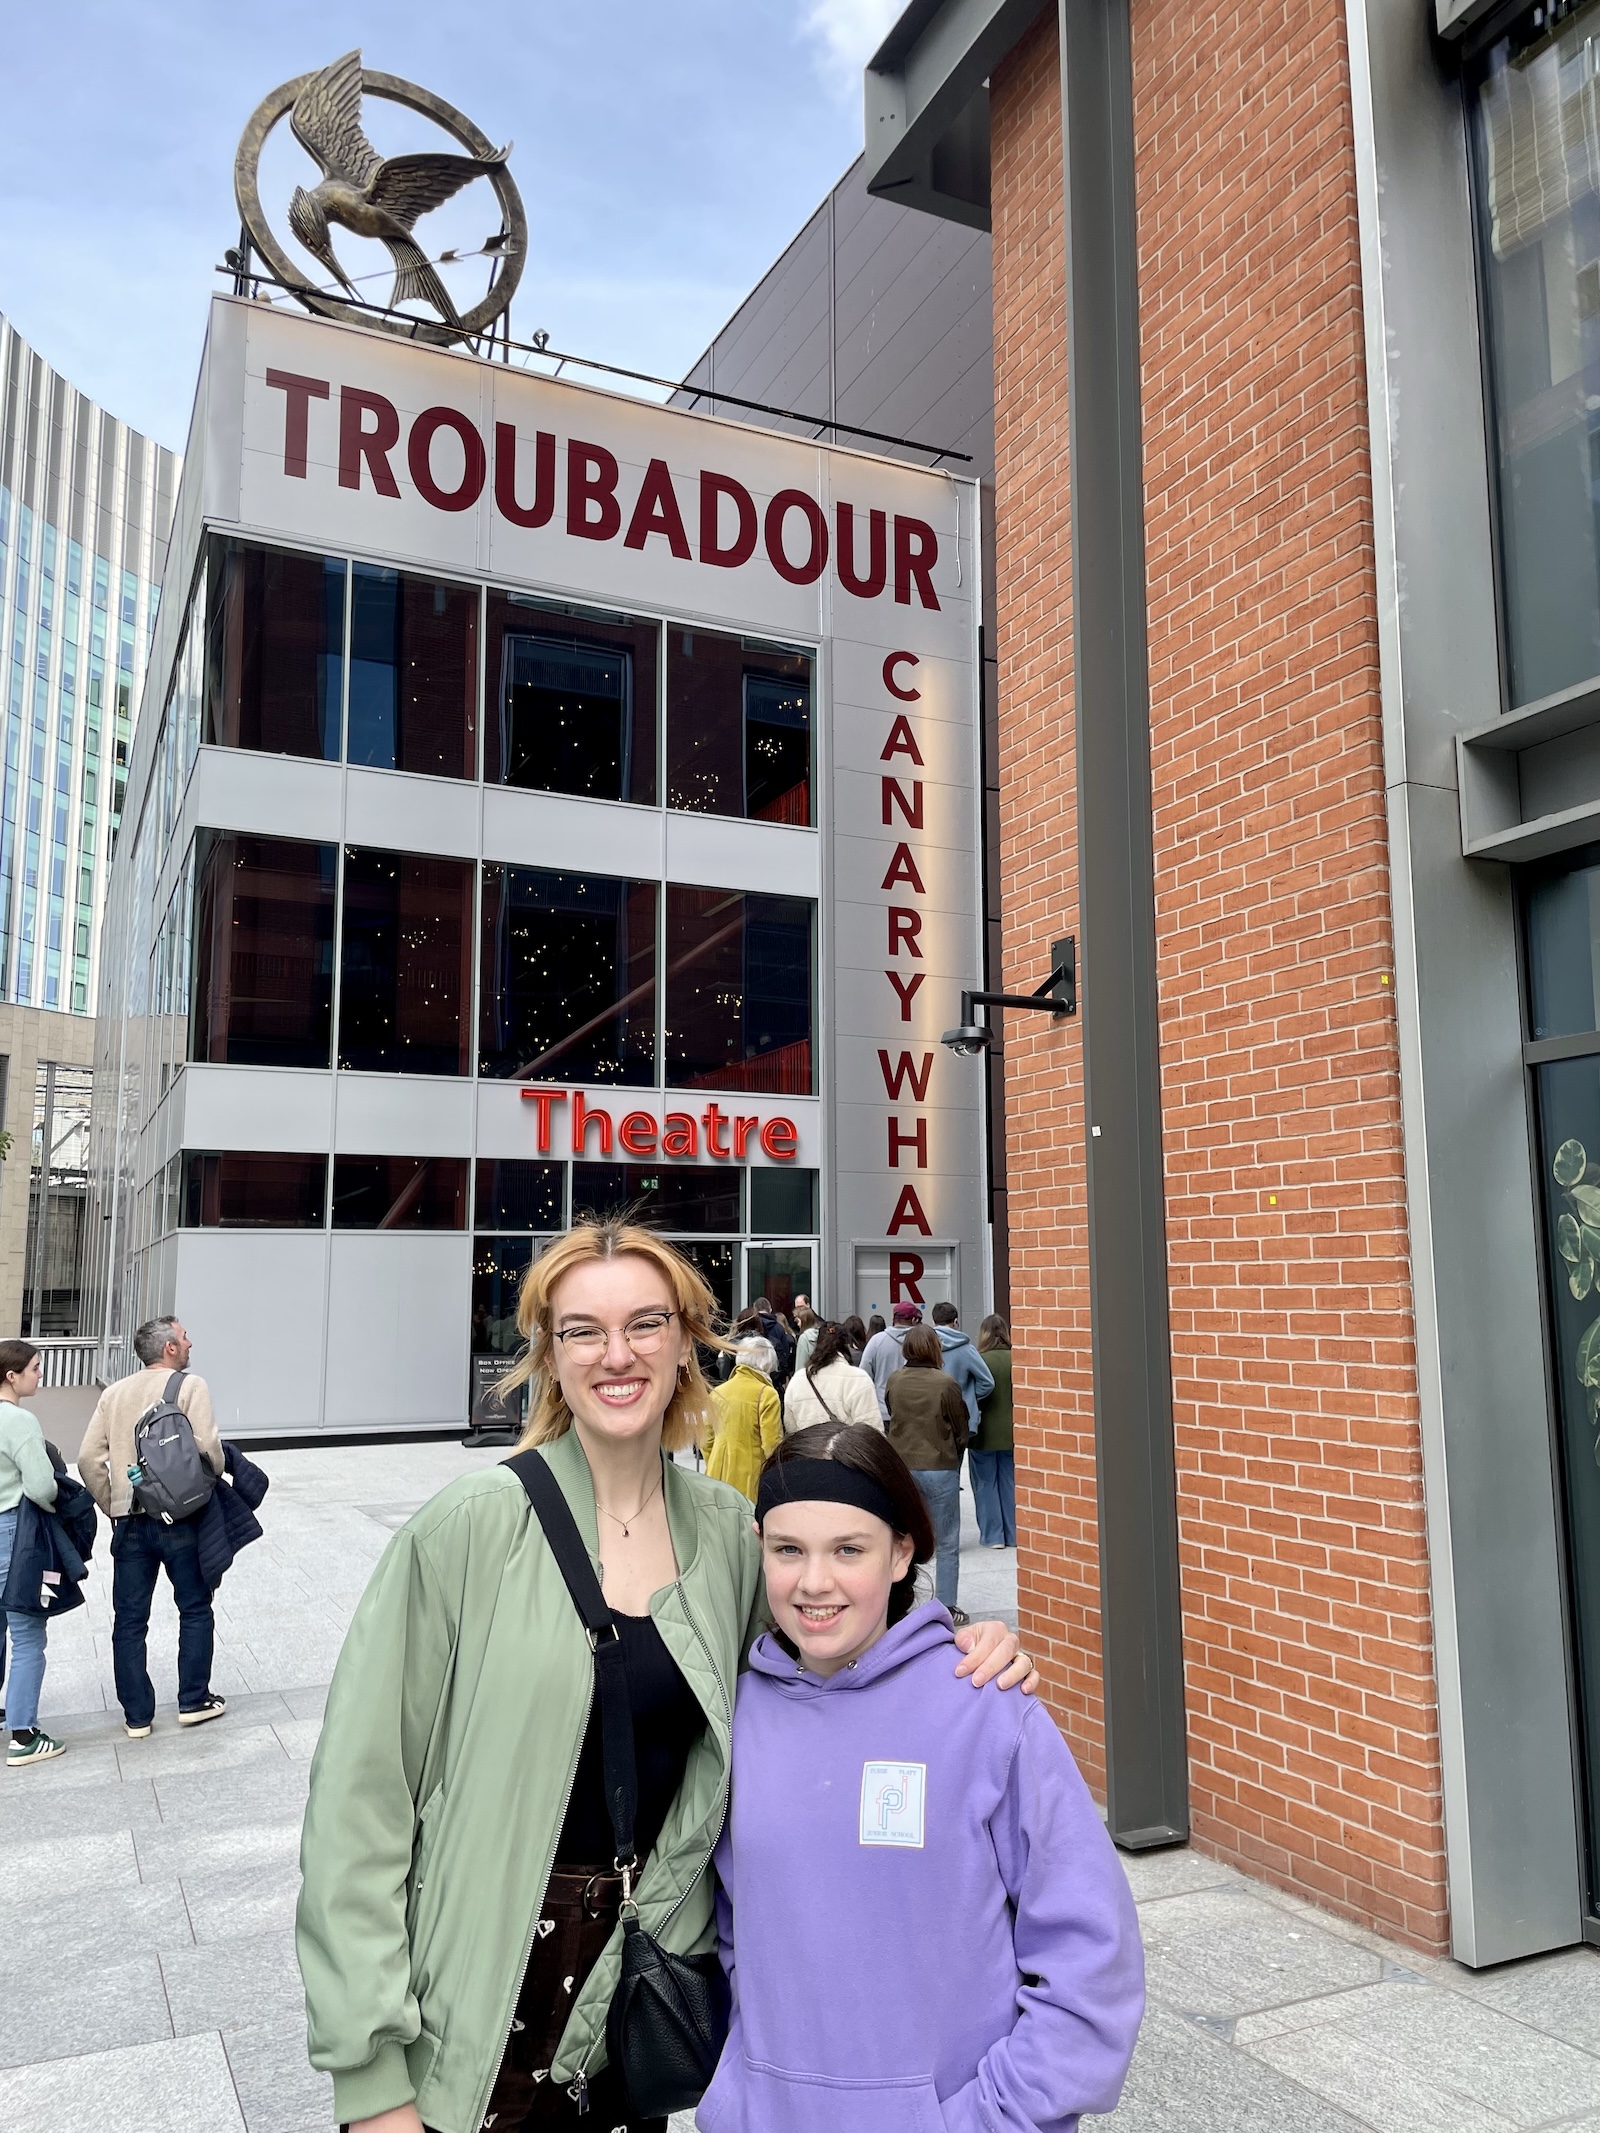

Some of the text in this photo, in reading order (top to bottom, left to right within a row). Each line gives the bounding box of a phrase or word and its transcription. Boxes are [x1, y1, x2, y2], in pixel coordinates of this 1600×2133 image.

[266, 367, 942, 612] TROUBADOUR
[877, 650, 935, 1305] CANARY WHAR
[519, 1087, 799, 1160] Theatre
